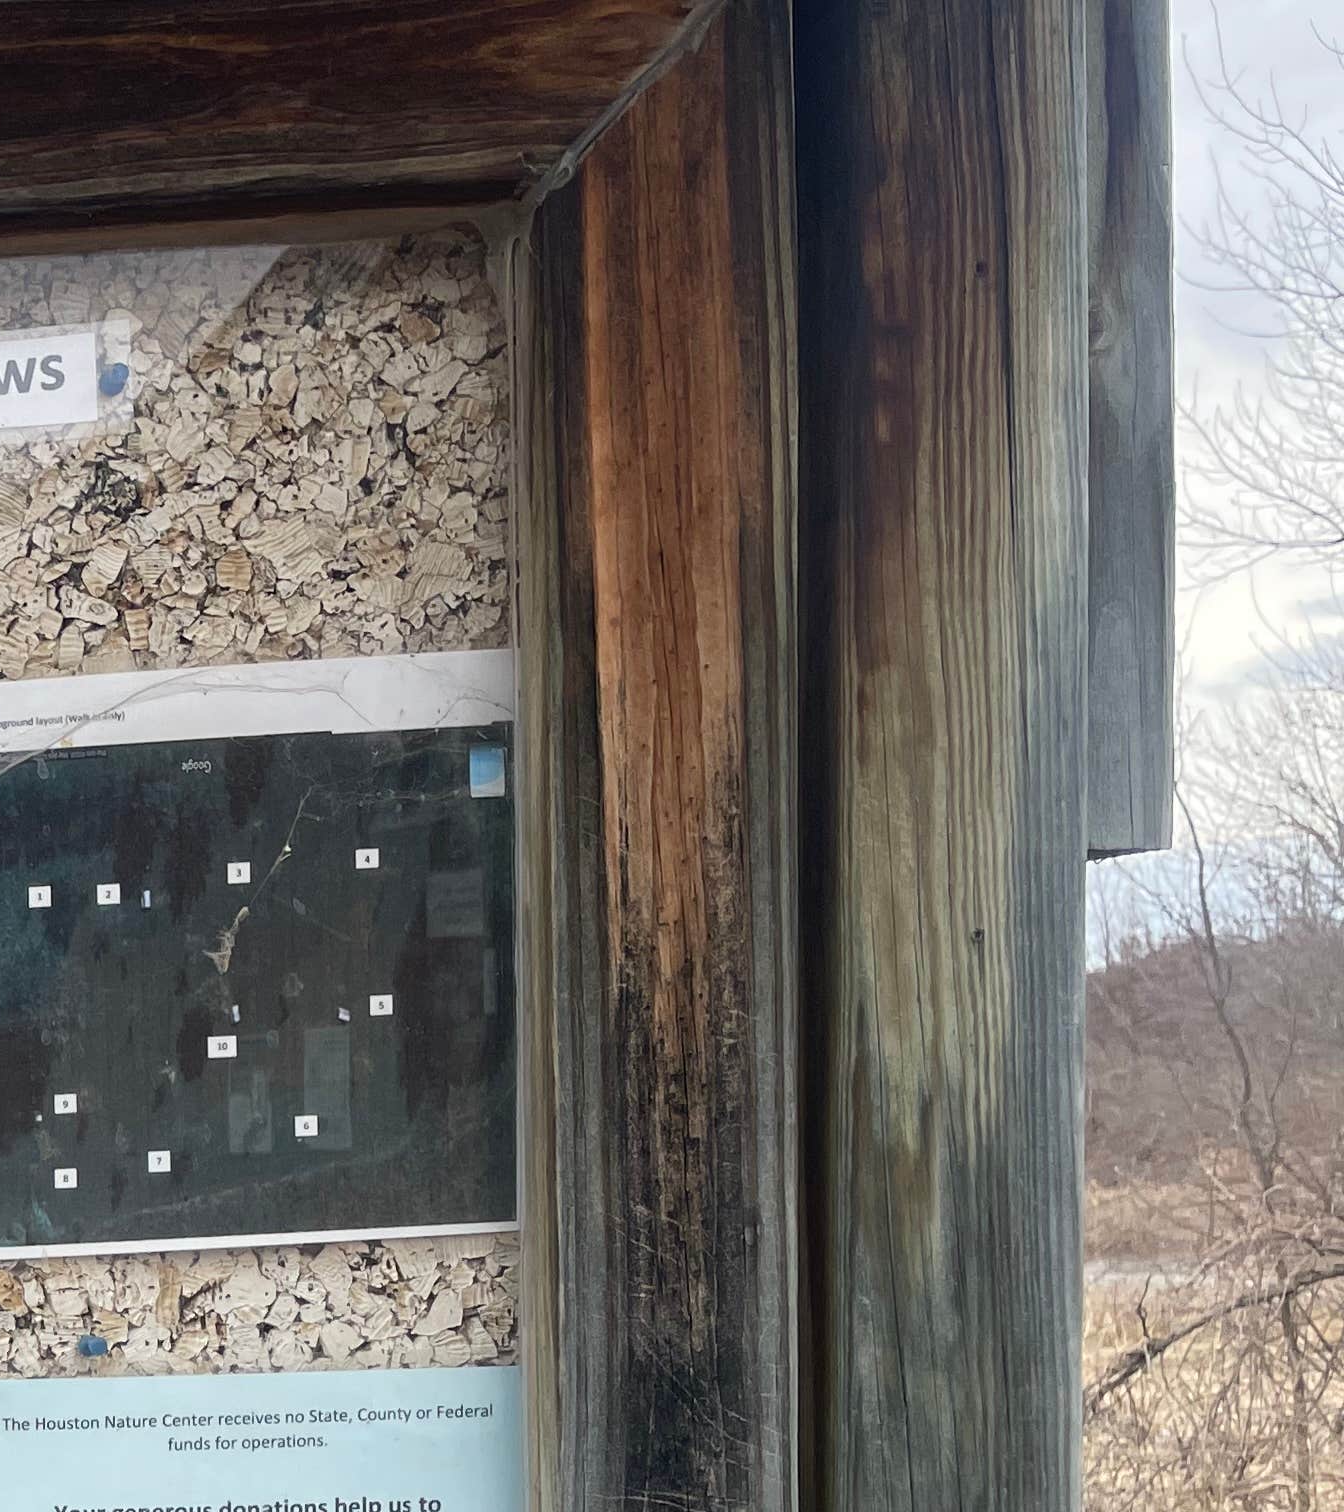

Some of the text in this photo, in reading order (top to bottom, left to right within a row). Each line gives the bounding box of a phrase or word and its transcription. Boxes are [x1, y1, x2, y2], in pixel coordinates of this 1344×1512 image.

[35, 716, 62, 728] layout
[1, 1402, 493, 1432] The Houston Nature Center receives no State, County or Federal
[167, 1433, 329, 1453] funds for operations.
